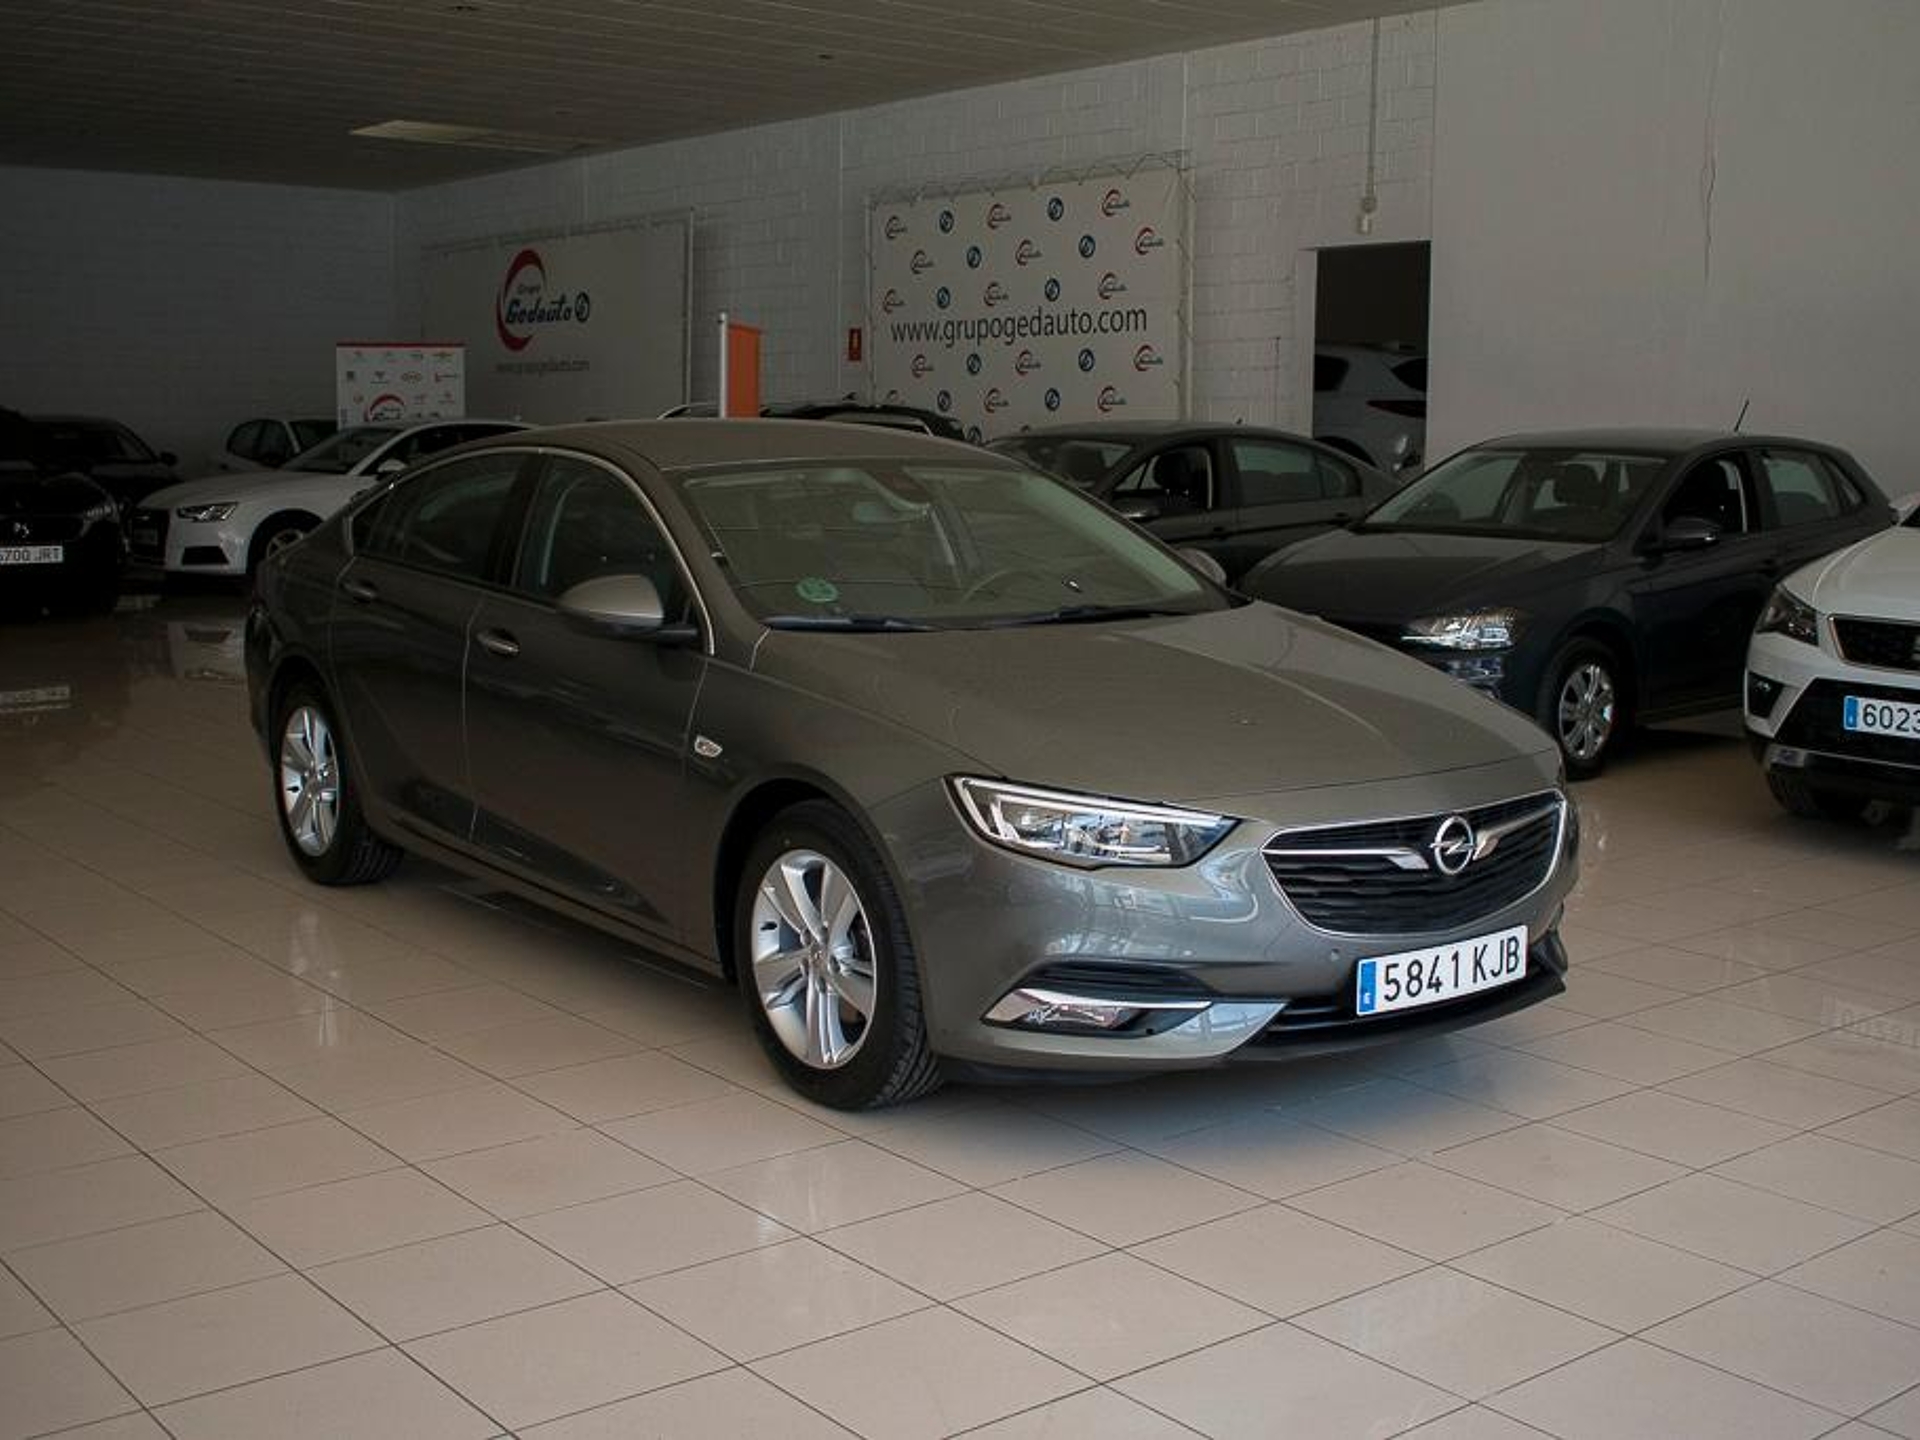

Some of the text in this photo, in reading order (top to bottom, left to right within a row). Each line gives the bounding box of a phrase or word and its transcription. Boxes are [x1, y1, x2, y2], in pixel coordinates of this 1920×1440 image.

[890, 306, 1148, 348] www.grupogedauto.com
[1863, 703, 1920, 734] 6023
[1383, 935, 1520, 1001] 5841 KJB
